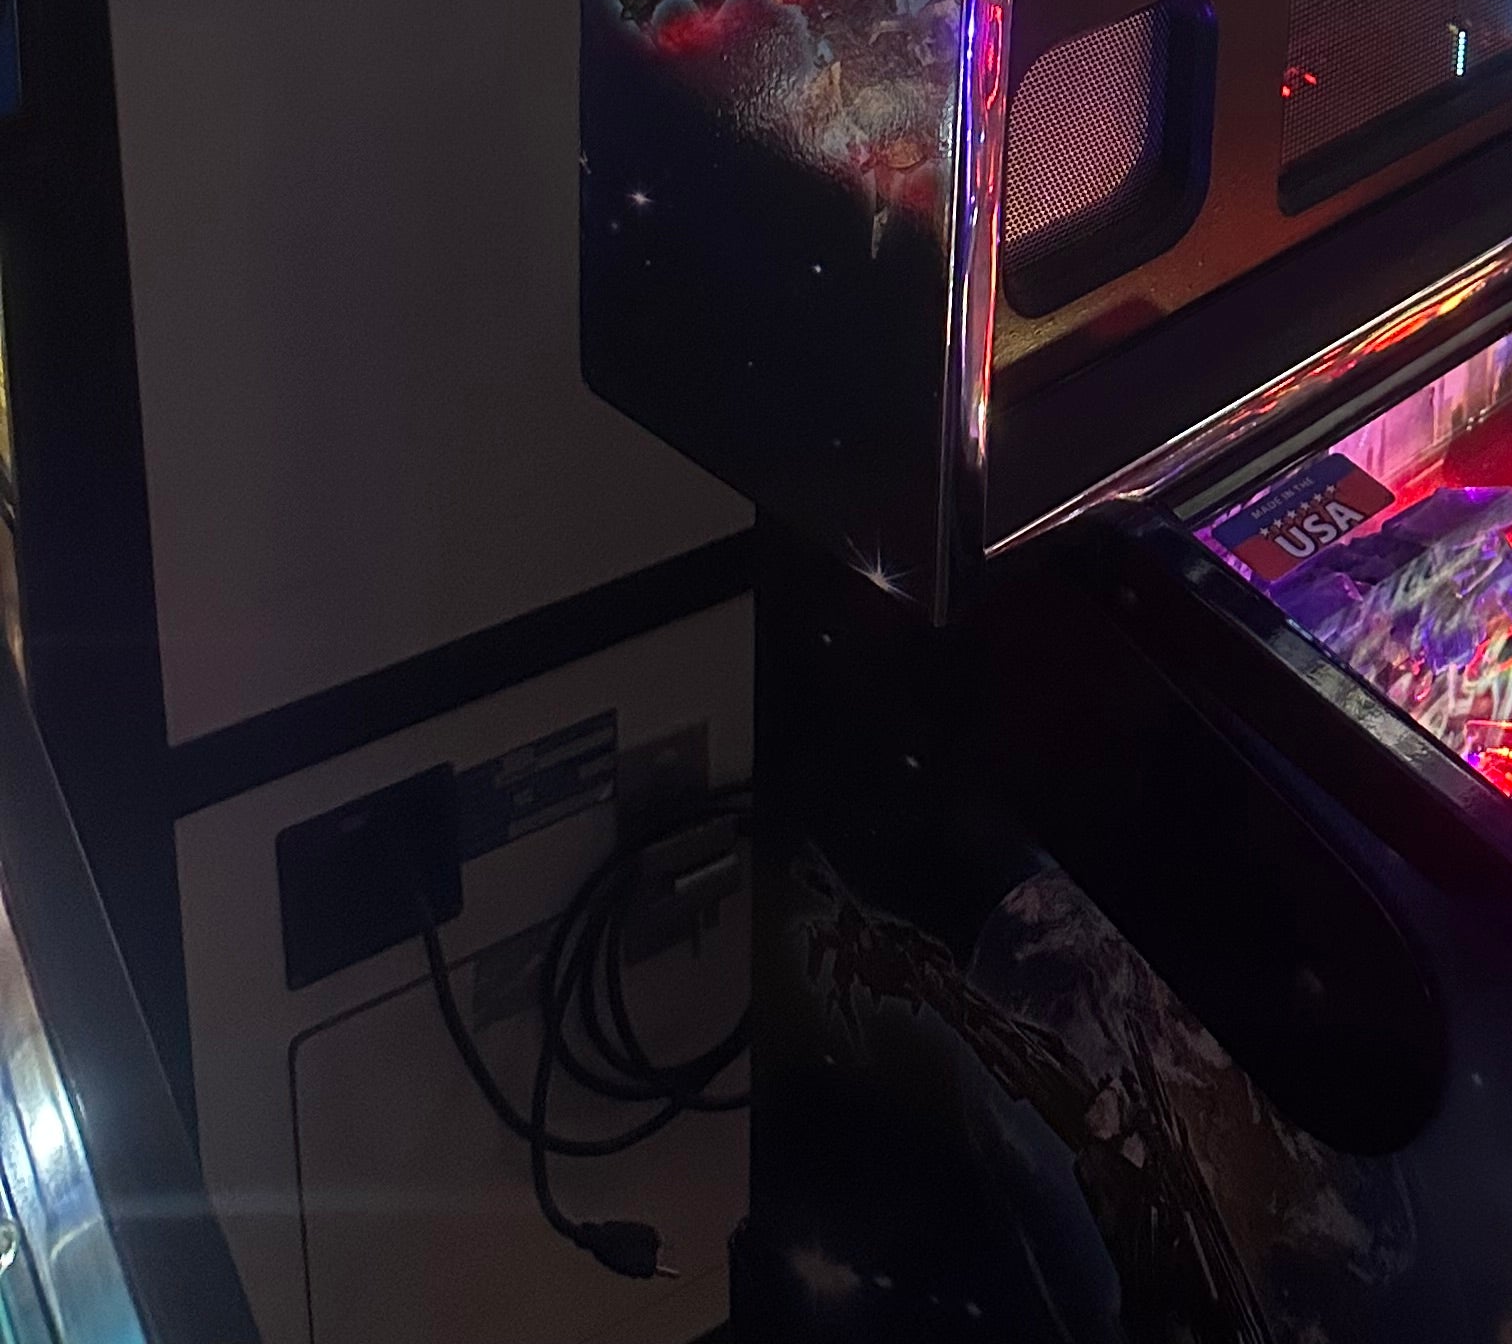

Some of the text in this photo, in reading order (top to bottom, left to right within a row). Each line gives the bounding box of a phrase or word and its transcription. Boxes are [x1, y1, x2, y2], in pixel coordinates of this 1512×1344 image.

[1251, 477, 1315, 520] MADE IN THE
[1273, 501, 1365, 558] USA
